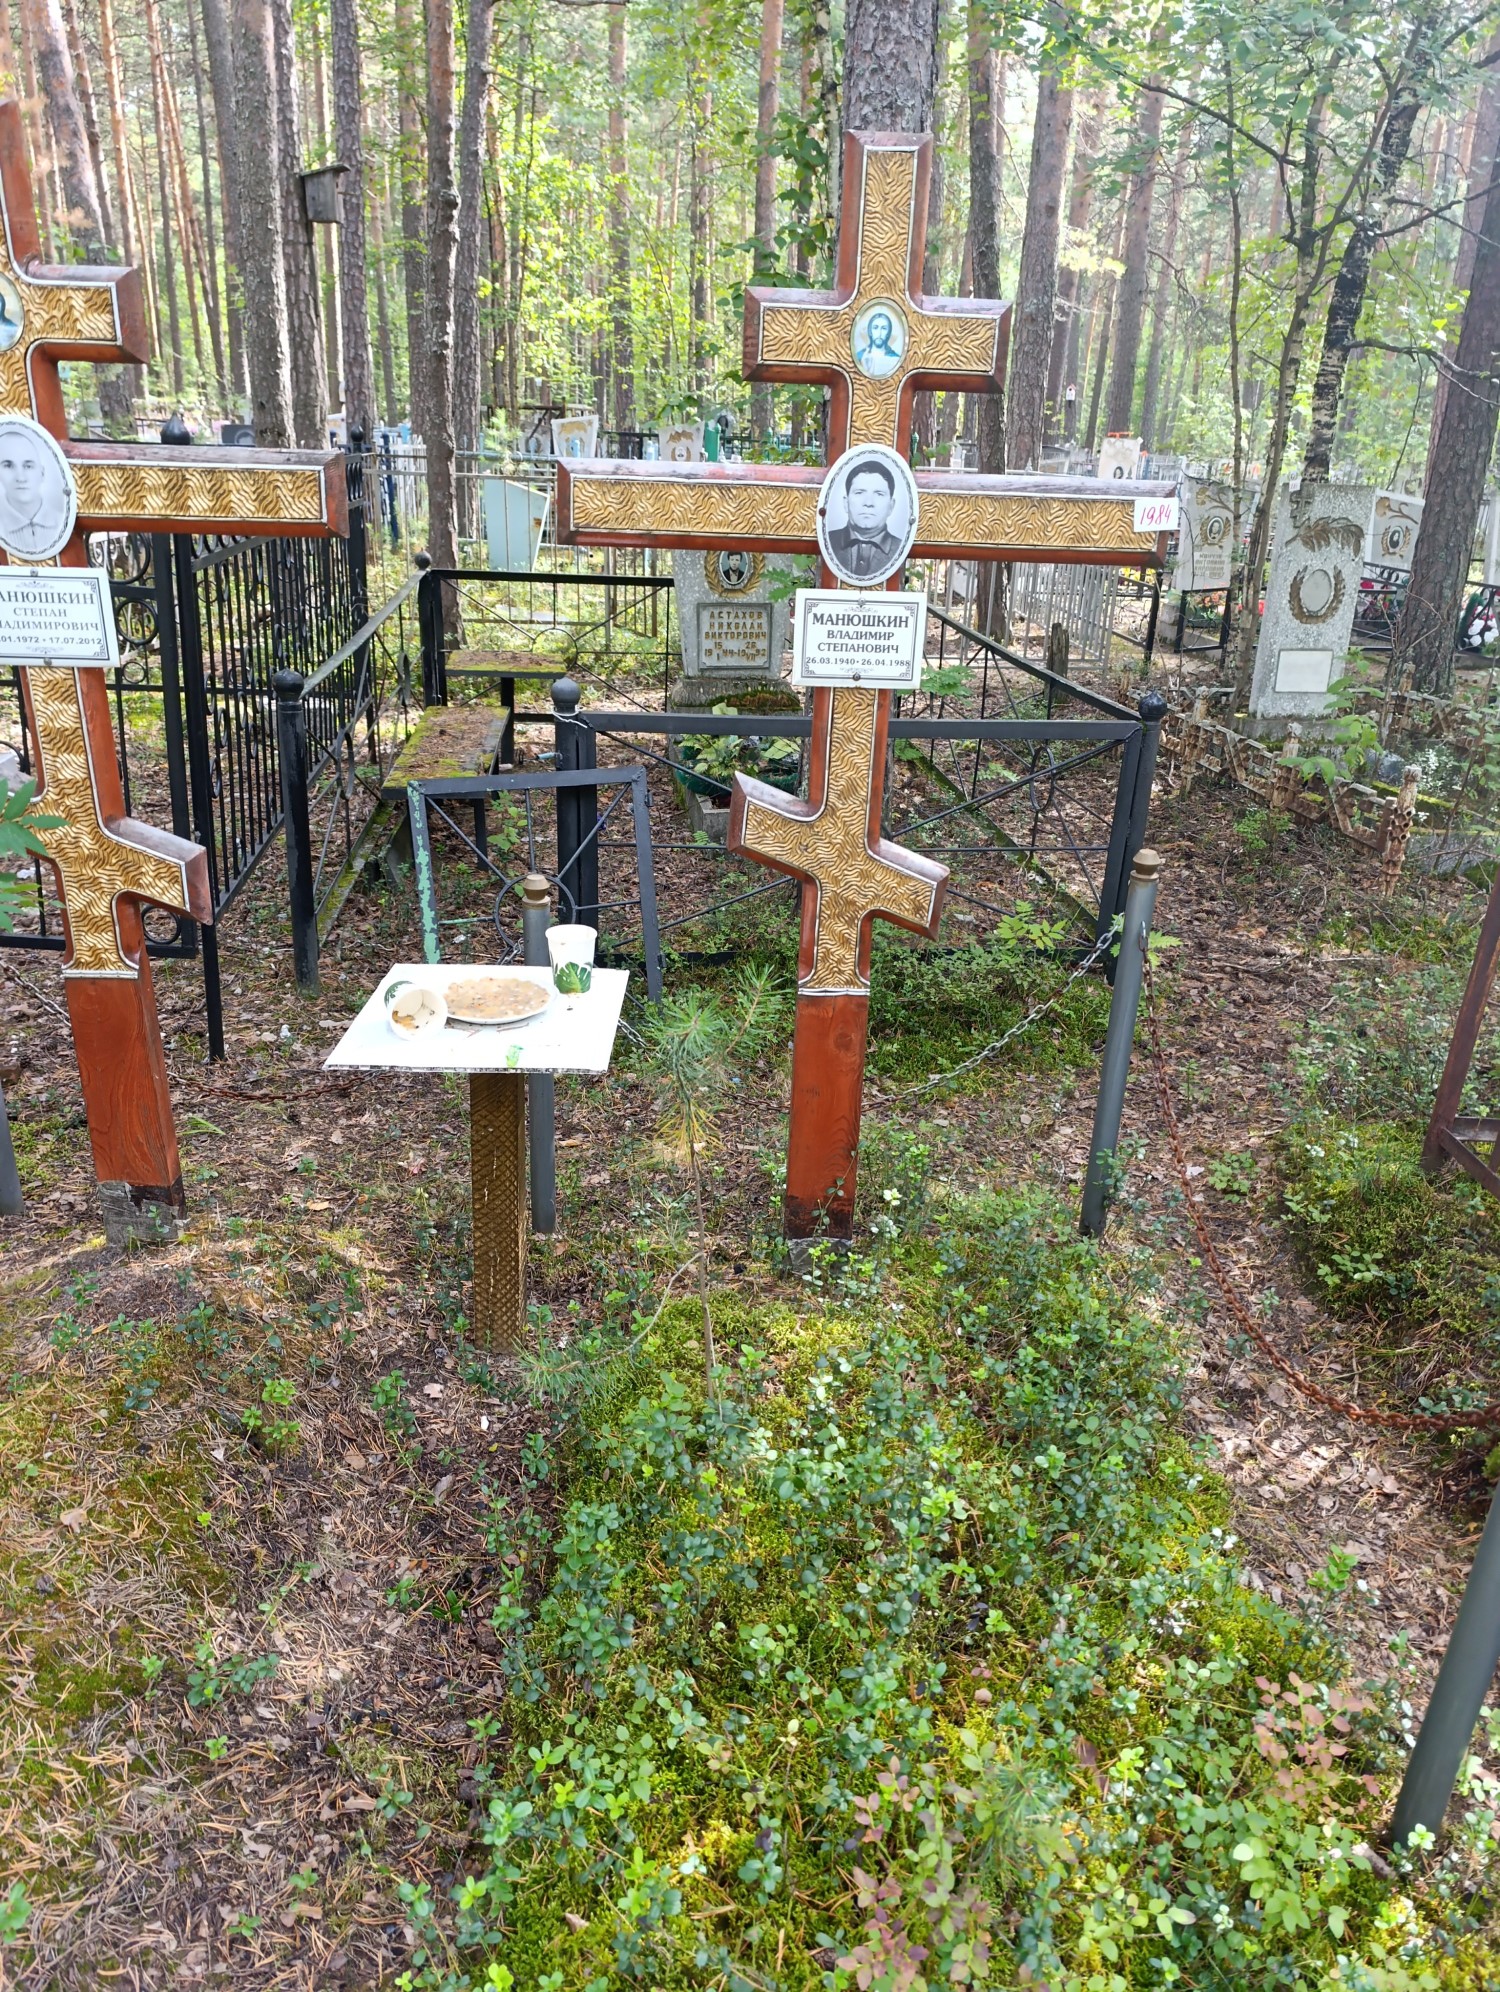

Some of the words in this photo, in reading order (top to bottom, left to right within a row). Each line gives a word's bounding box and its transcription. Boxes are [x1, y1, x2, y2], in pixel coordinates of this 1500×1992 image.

[1140, 504, 1171, 526] 1984
[13, 607, 67, 617] СТЕПАН
[709, 611, 763, 619] АСТАХОВ
[812, 613, 909, 628] МАНЮШКИН
[49, 636, 103, 645] 17.07.2012
[704, 631, 767, 640] ВИКТОРОВИЧ
[827, 630, 895, 641] ВЛАДИМИР
[817, 642, 899, 654] СТЕПАНОВИЧ
[806, 656, 856, 665] 26.03.1940
[861, 658, 911, 667] 26.04.1988
